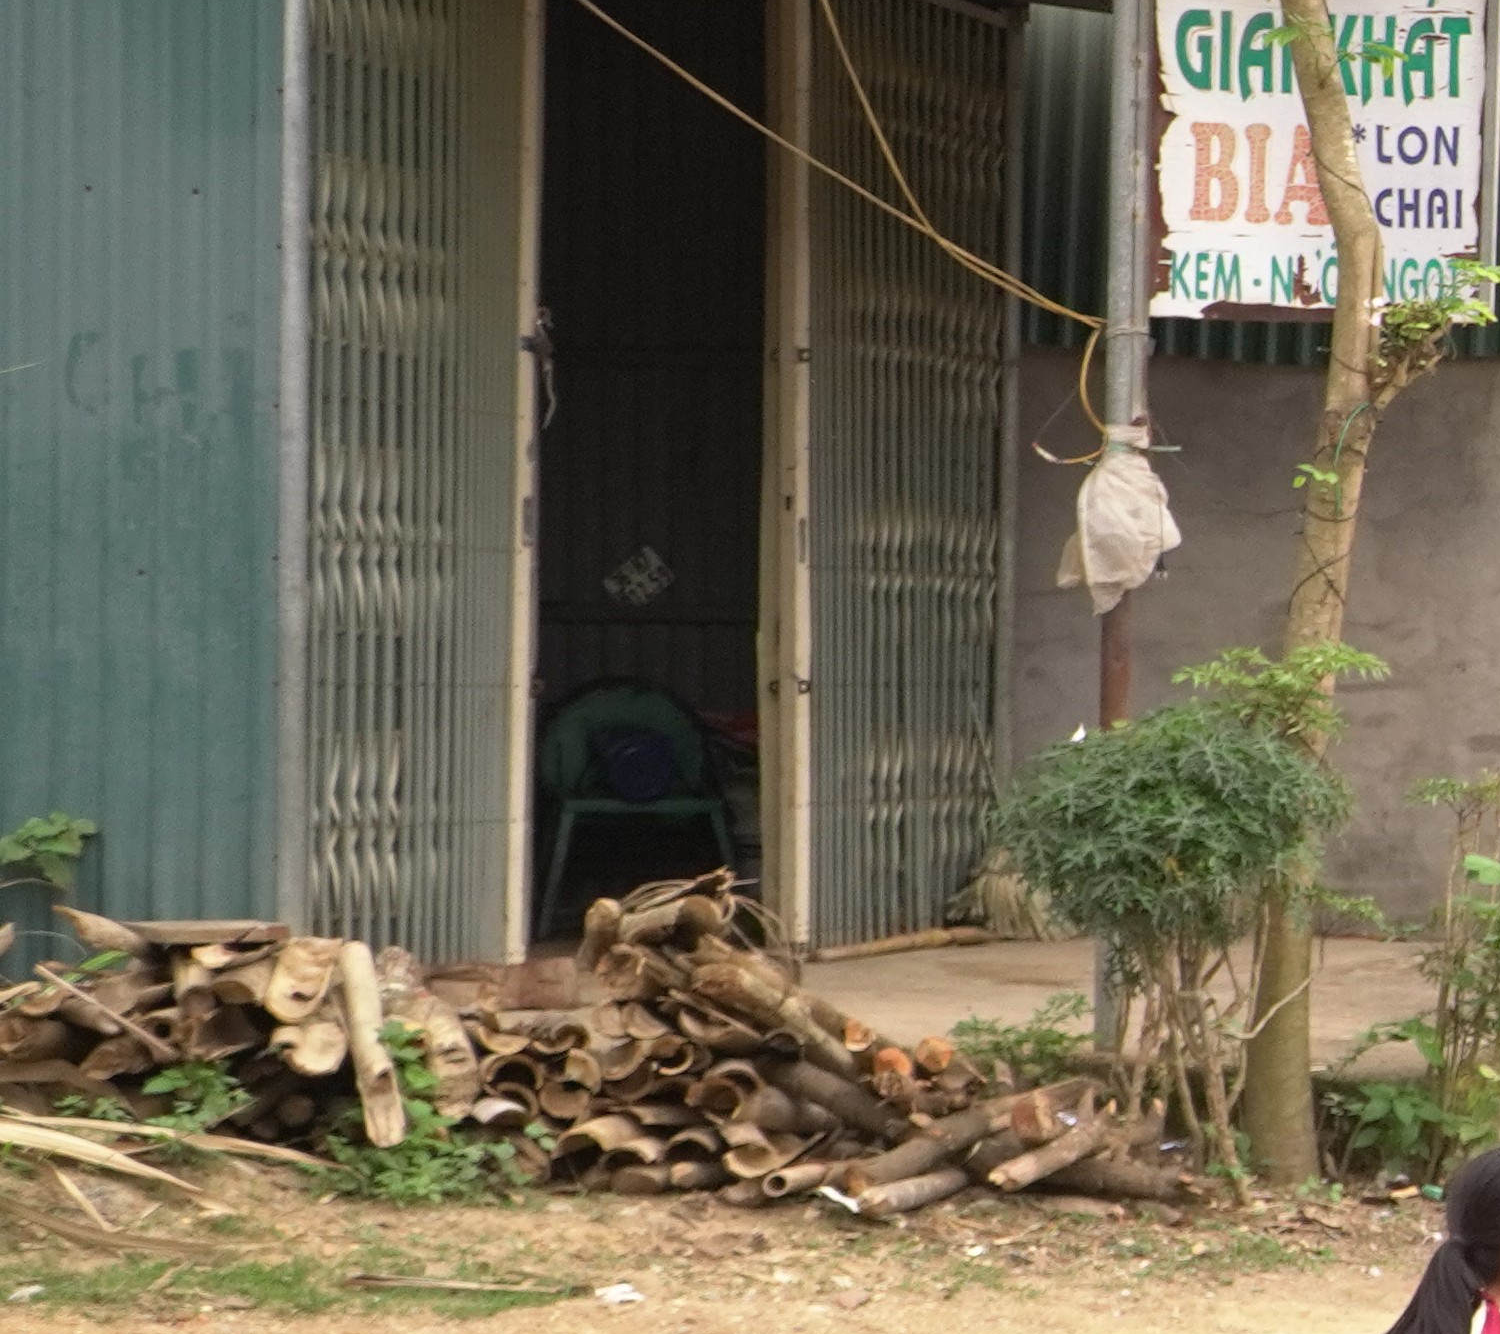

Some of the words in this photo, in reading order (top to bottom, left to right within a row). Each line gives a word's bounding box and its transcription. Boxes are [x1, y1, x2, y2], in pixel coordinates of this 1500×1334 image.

[1377, 124, 1461, 166] LON
[1188, 122, 1332, 225] BIA
[1375, 187, 1463, 230] CHAI
[1170, 252, 1242, 301] KEM
